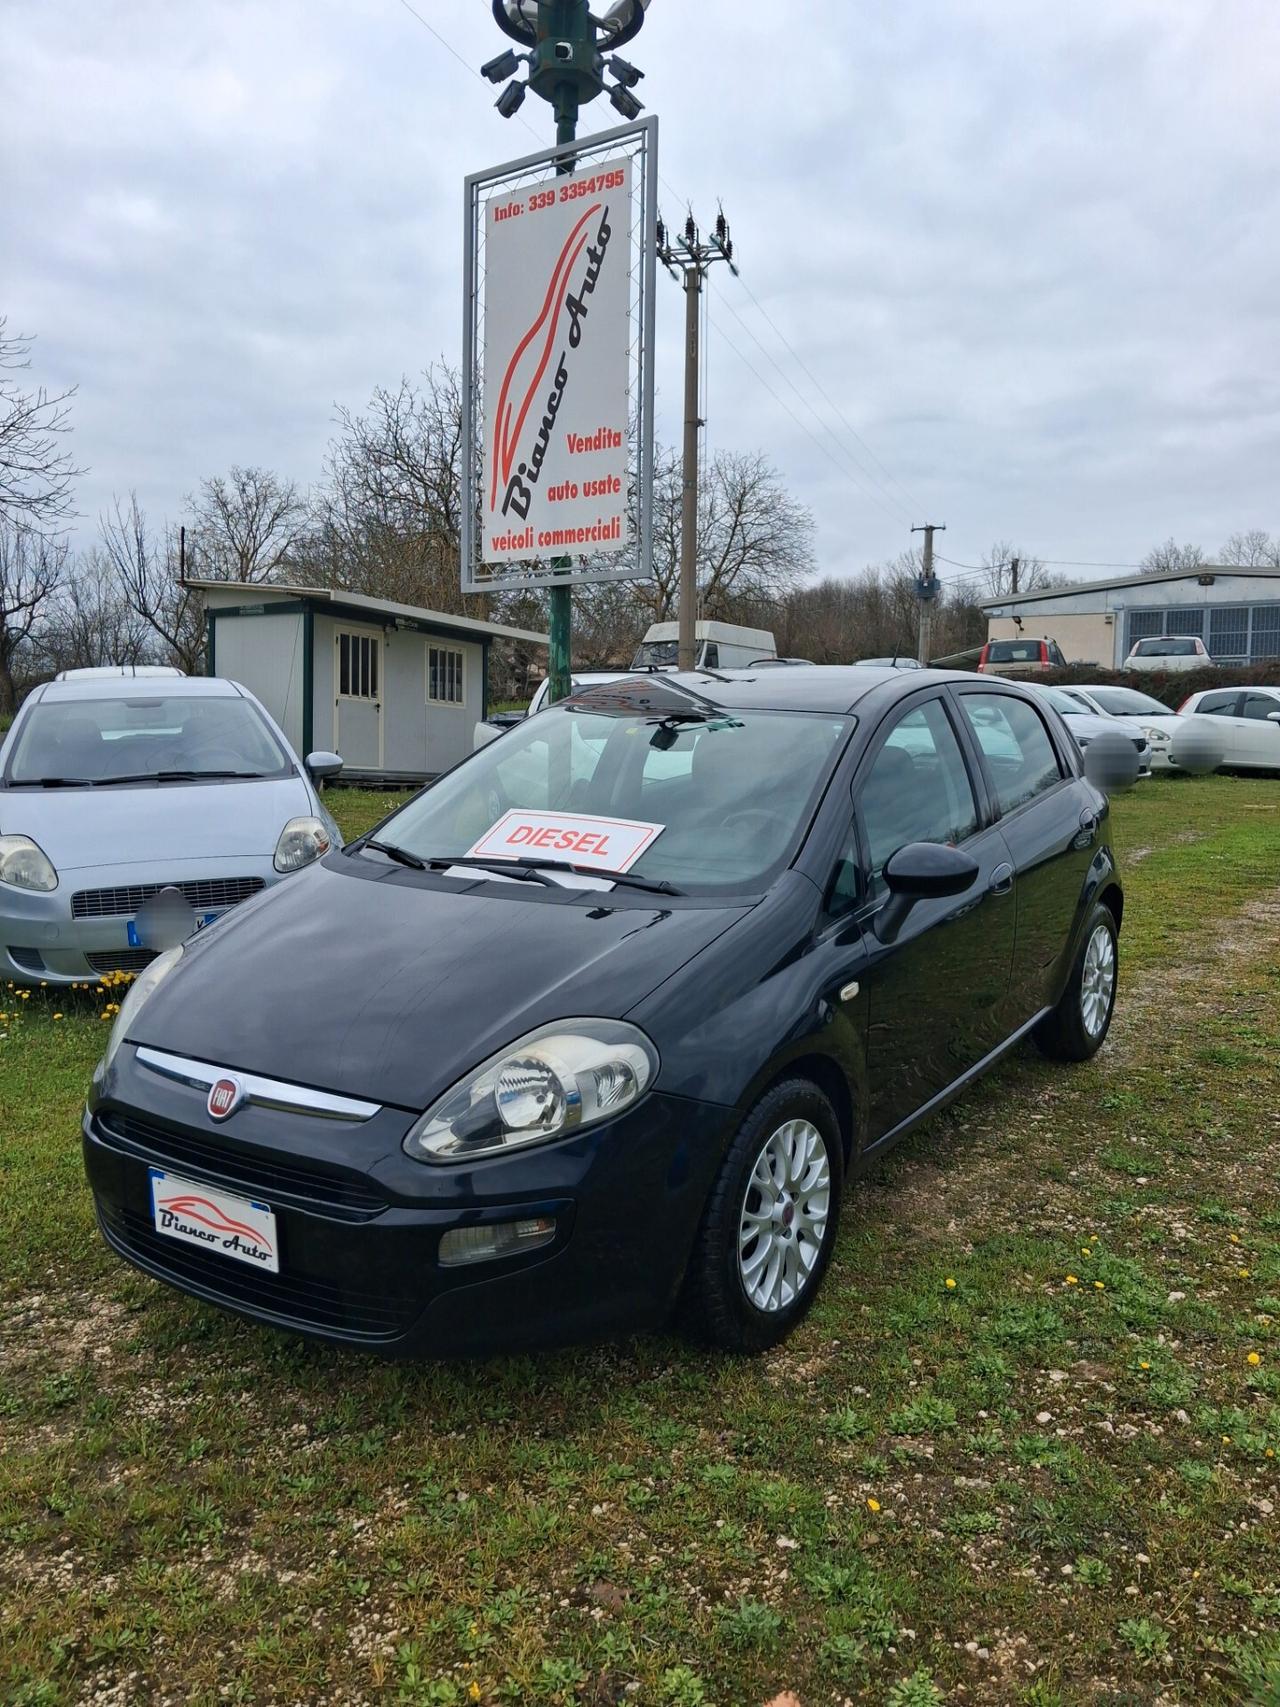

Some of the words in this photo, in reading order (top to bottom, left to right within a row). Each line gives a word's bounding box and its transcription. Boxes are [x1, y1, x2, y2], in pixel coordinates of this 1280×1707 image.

[494, 202, 525, 222] Info:
[528, 189, 556, 212] 339
[559, 168, 625, 203] 3354795
[501, 351, 568, 521] Bianco
[565, 205, 612, 349] Auto
[567, 426, 622, 454] Vendita
[548, 480, 578, 502] auto
[583, 474, 621, 496] usate
[492, 527, 534, 551] veicoli
[538, 516, 621, 547] commerciali
[506, 825, 610, 856] DIESEL
[212, 1087, 233, 1109] FIAT
[158, 1208, 221, 1243] Bianco
[222, 1235, 273, 1261] Auto
